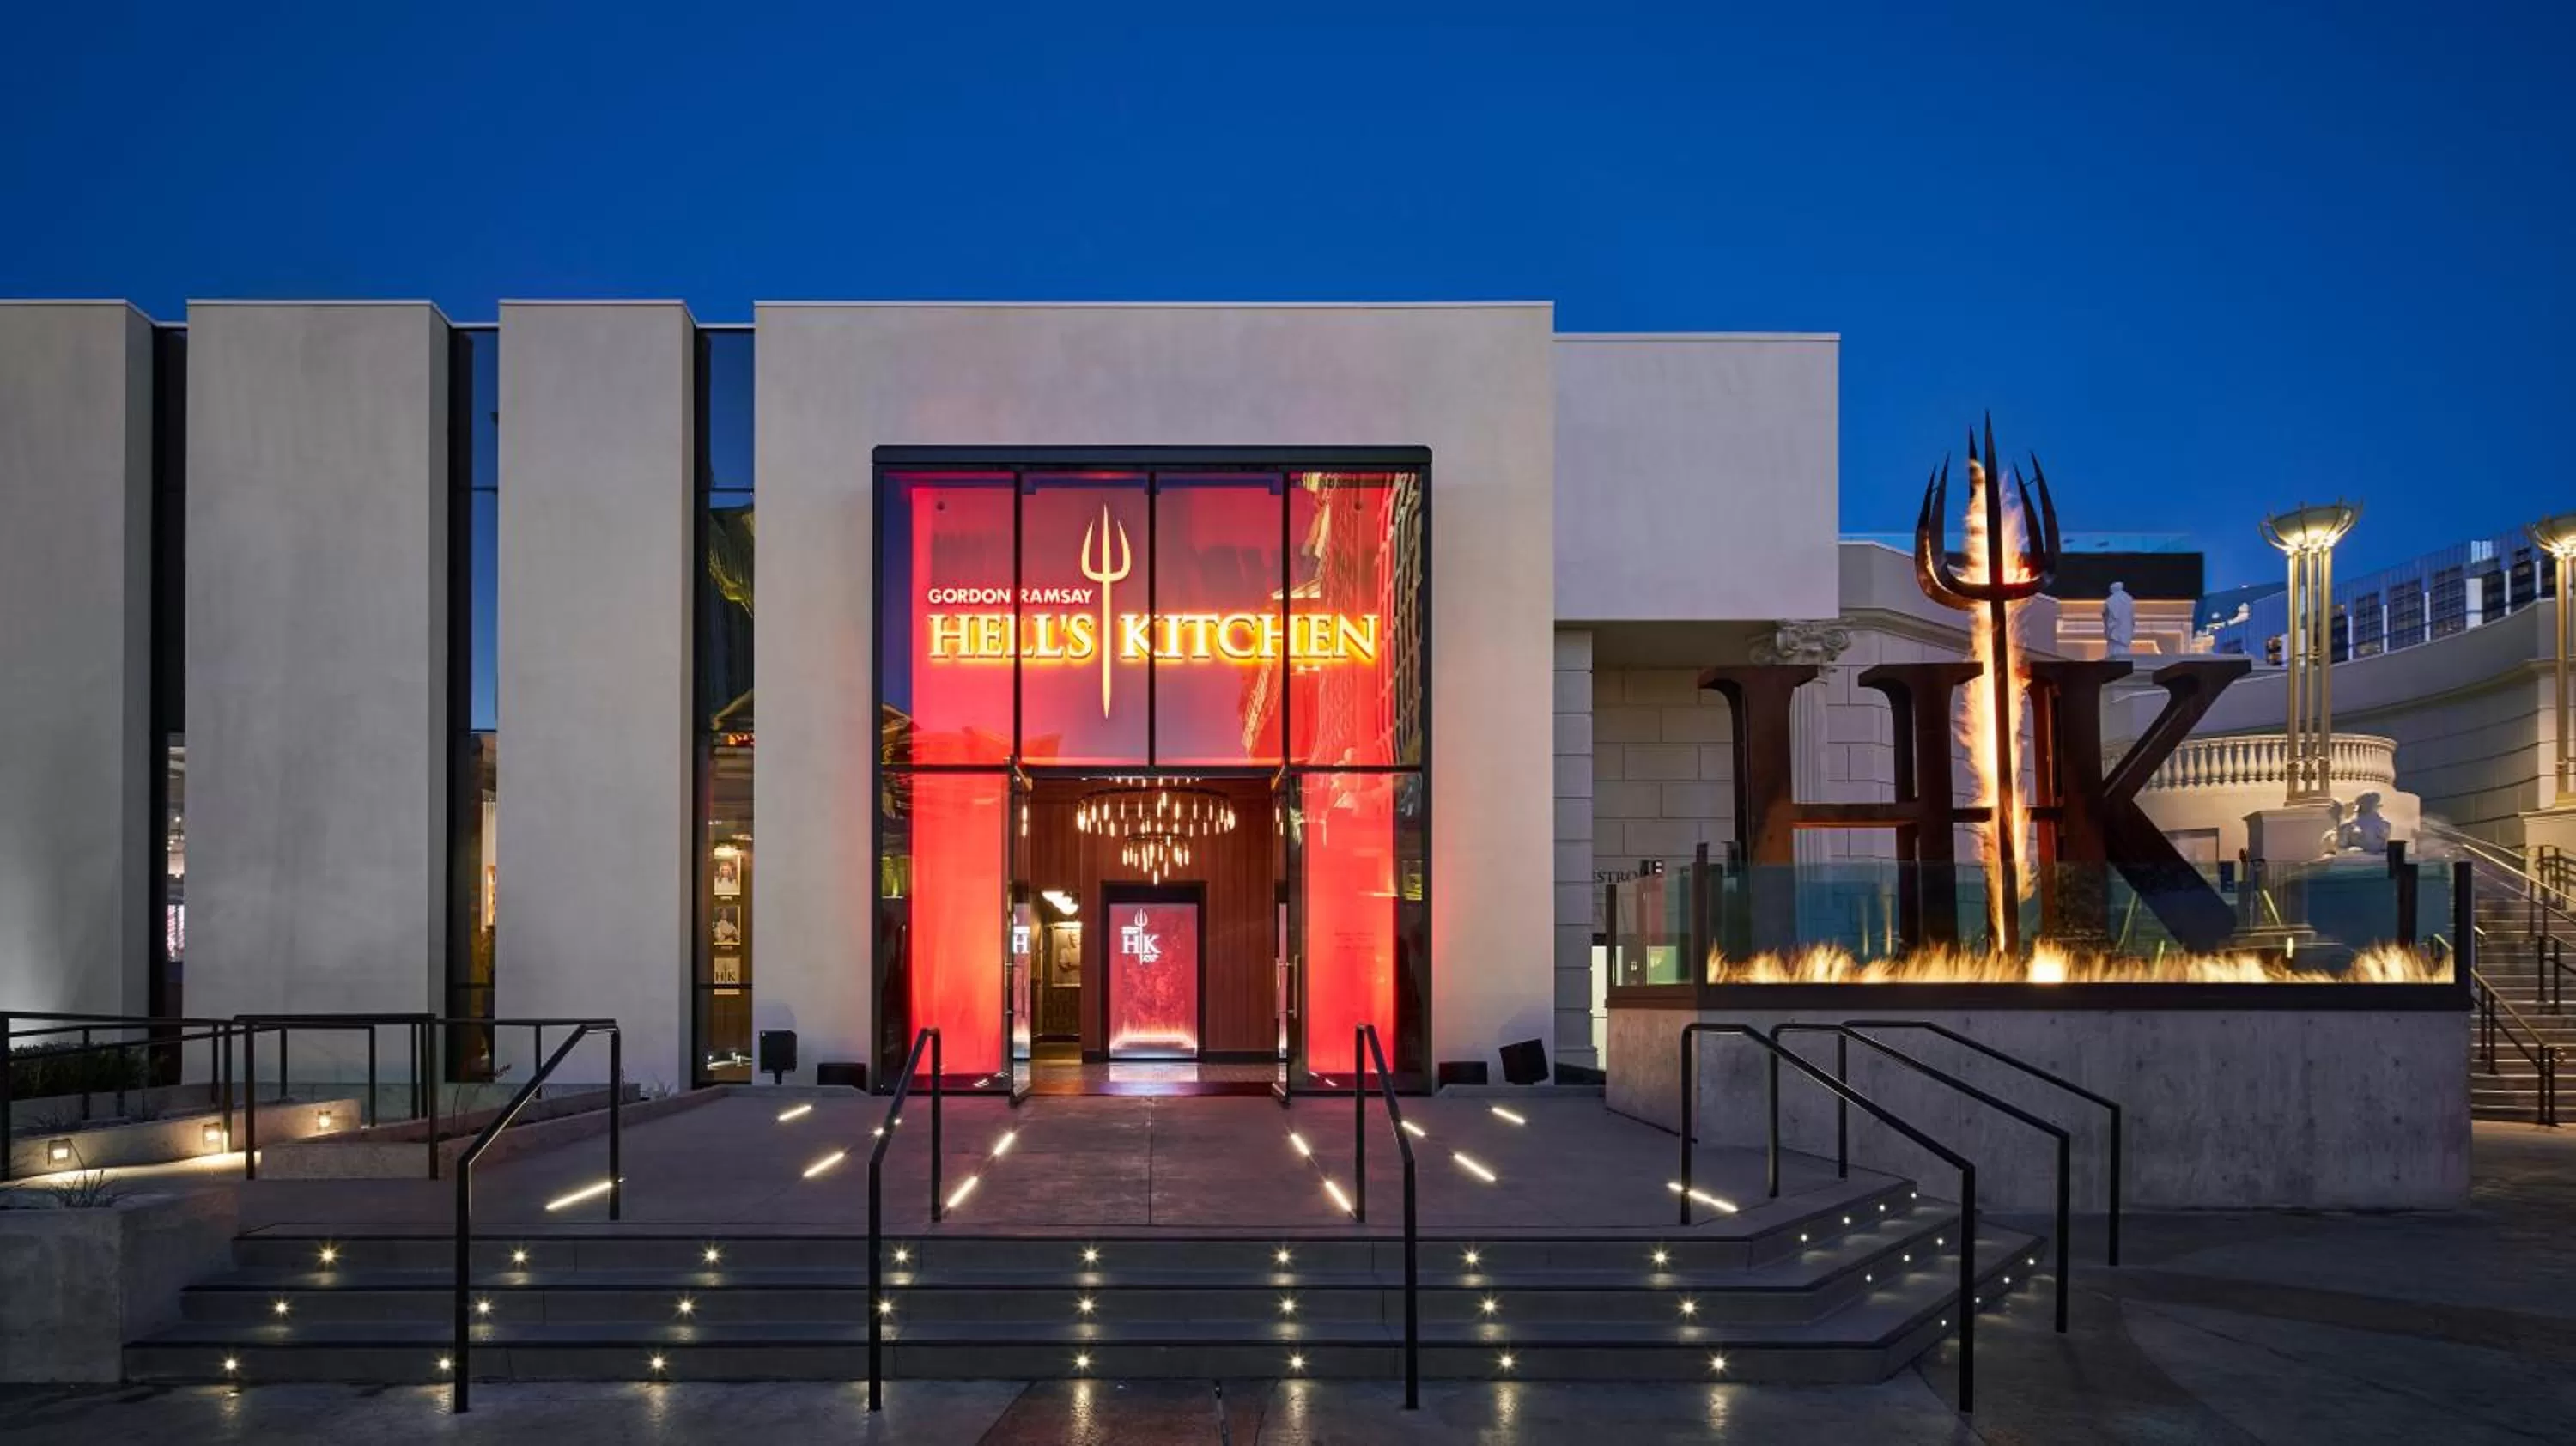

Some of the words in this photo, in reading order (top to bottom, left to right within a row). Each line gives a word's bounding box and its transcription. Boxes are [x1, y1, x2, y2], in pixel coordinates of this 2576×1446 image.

[927, 588, 1011, 604] GORDON
[1019, 588, 1093, 604] RAMSAY
[927, 614, 1093, 659] HELL'S
[1119, 612, 1379, 659] KITCHEN
